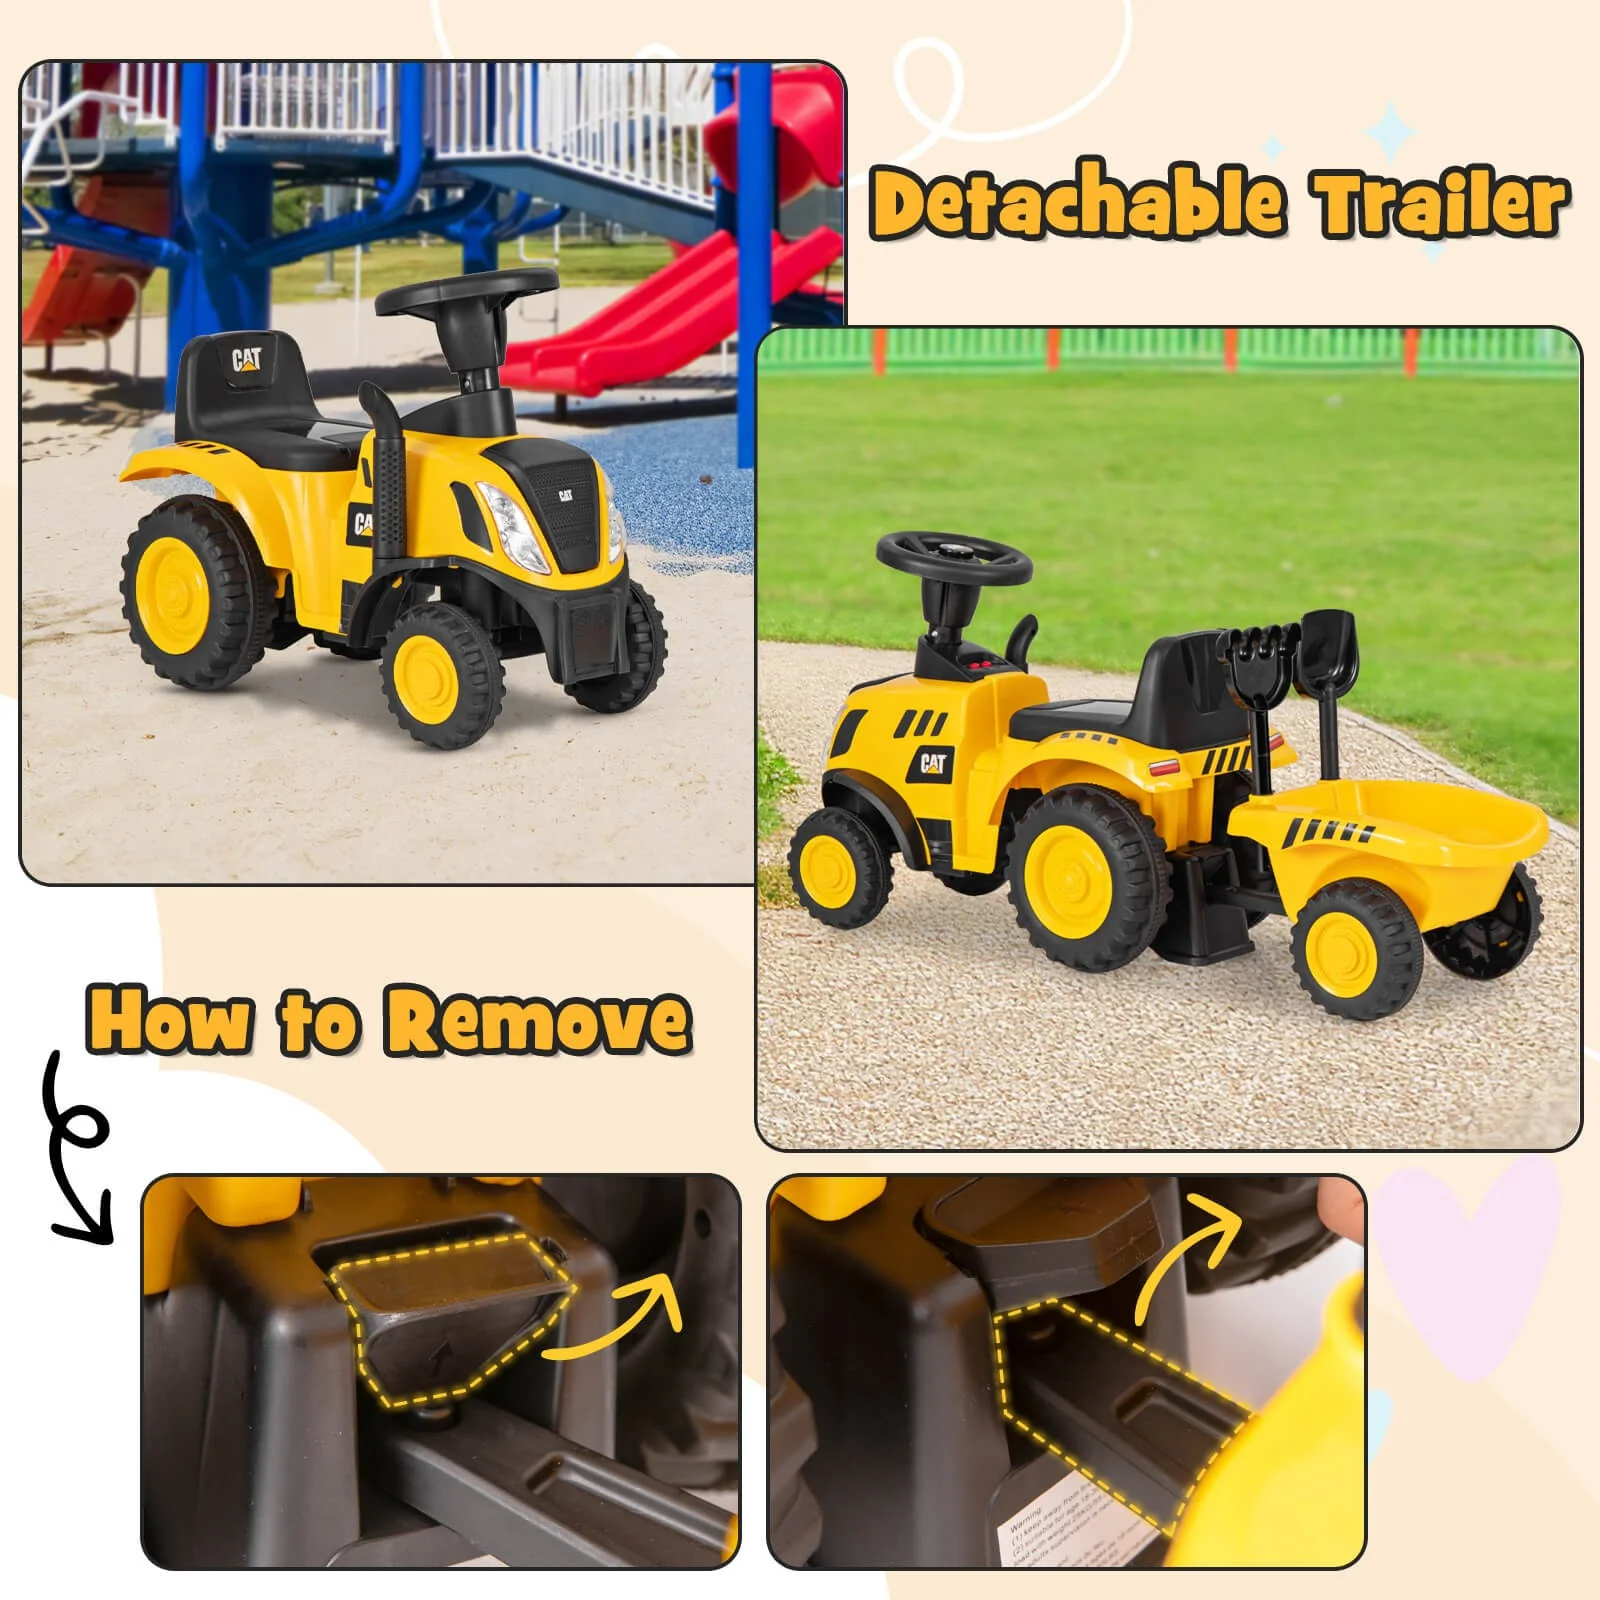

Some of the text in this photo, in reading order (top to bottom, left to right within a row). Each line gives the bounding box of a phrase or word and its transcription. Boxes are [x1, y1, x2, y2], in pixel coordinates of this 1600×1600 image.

[232, 347, 263, 372] CAT
[354, 512, 373, 536] CA
[921, 753, 948, 774] CAT
